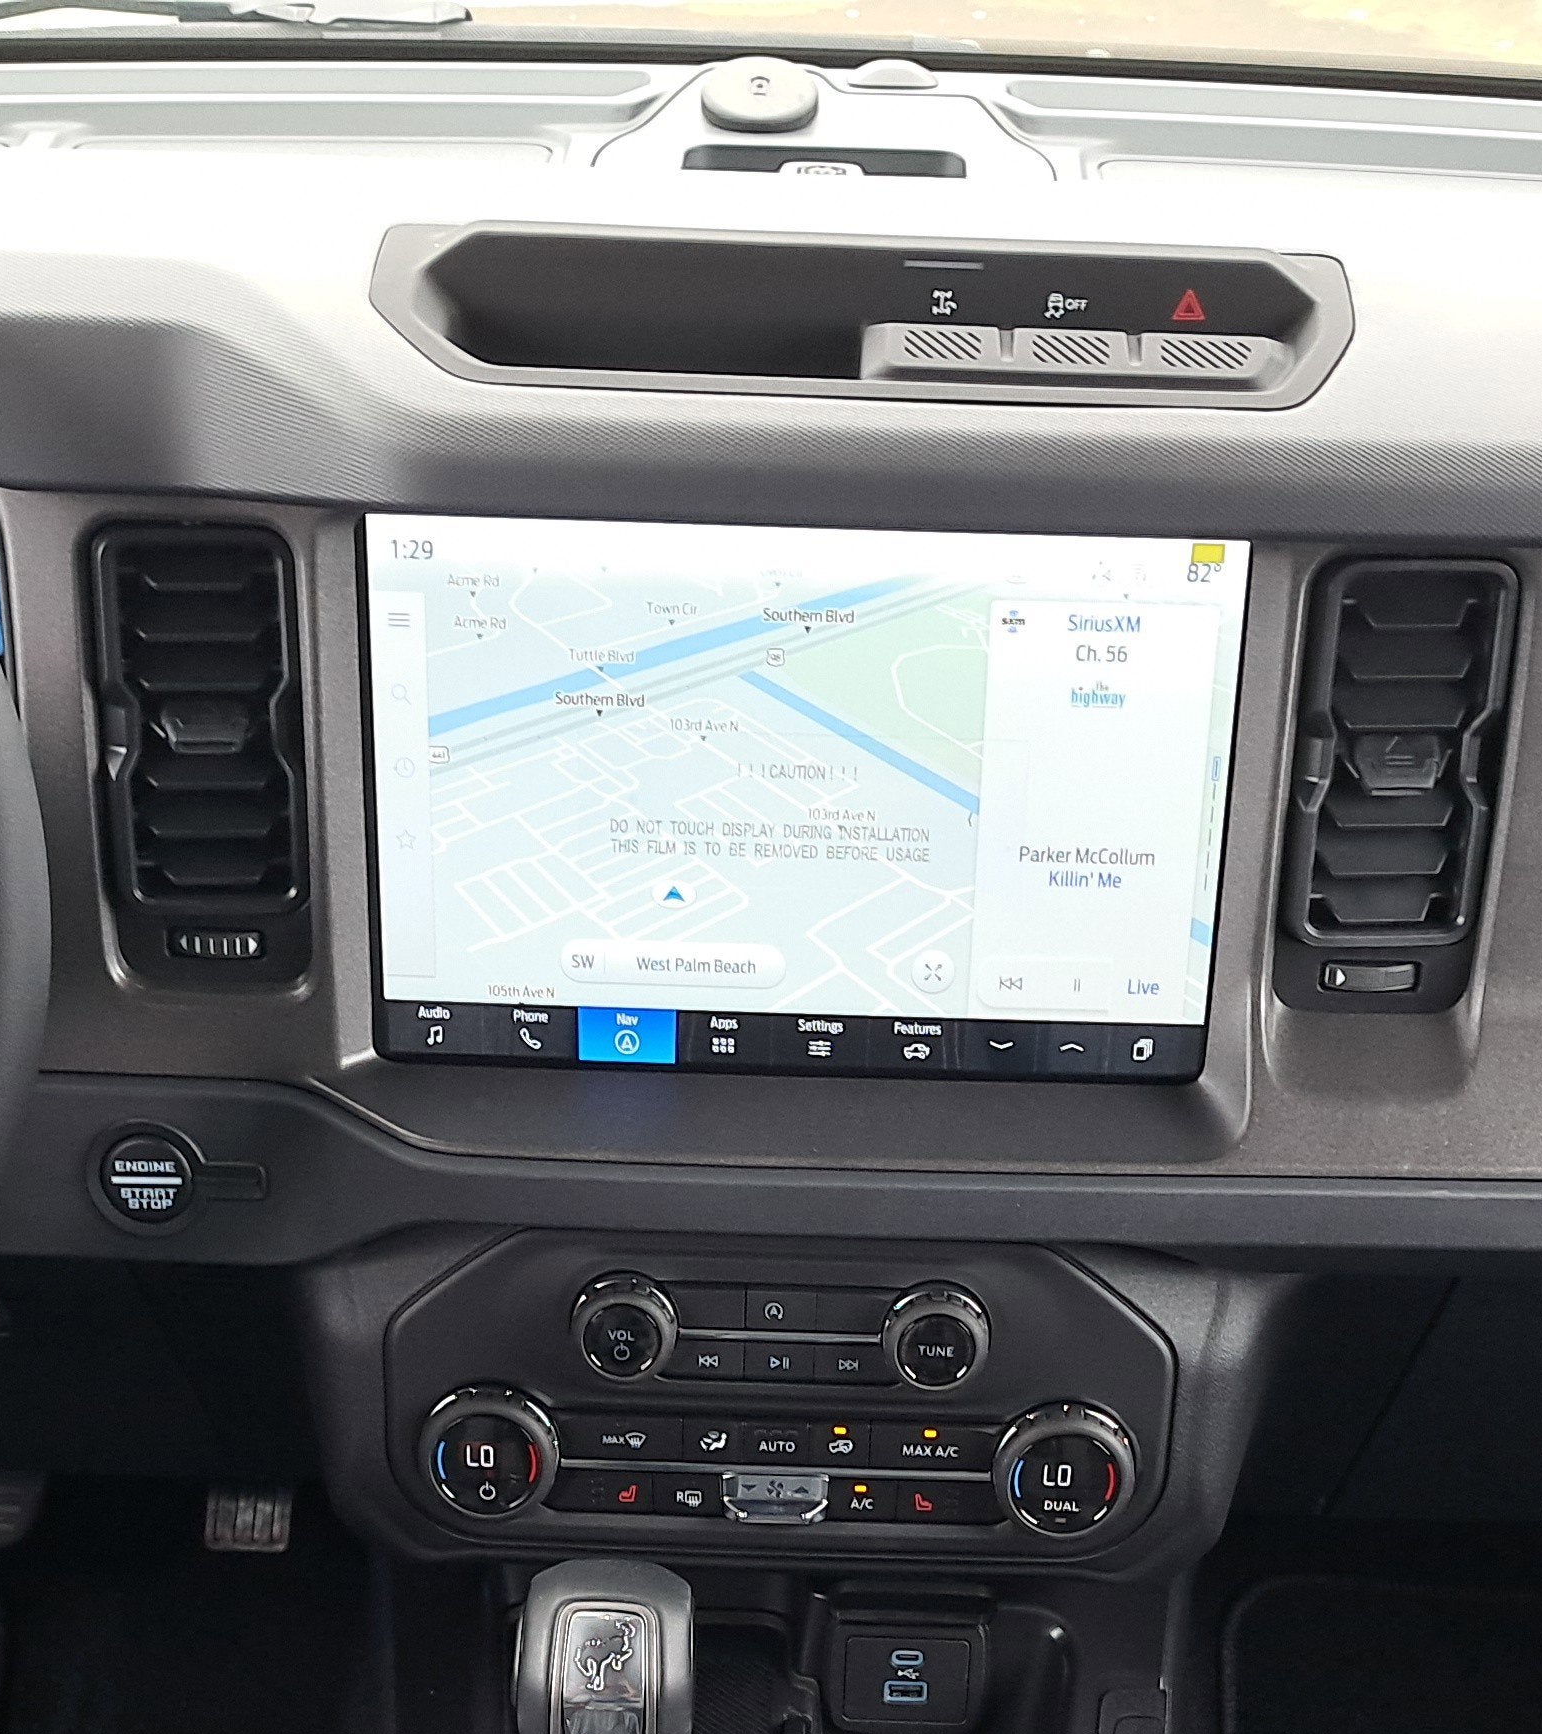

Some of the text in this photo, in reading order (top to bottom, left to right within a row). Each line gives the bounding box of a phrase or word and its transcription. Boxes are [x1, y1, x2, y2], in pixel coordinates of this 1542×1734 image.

[1065, 298, 1089, 312] OFF
[390, 538, 435, 562] 1:29
[447, 573, 500, 588] Acme Rd
[647, 602, 681, 616] Town
[763, 607, 855, 624] Southern Blvd
[454, 616, 507, 631] Acme Rd
[1067, 614, 1141, 633] SiriusXM
[569, 649, 635, 664] Tuttle Blvd
[1075, 644, 1128, 662] Ch. 56
[555, 692, 645, 708] Southern Blvd
[1071, 687, 1126, 708] highway
[669, 719, 740, 734] 103rd Ave N
[610, 819, 930, 843] DO NOT TOUCH DISPLAY DURING INSTALLATION
[610, 839, 930, 863] THIS FILM IS TO BE REMOVED BEFORE USAGE
[1019, 846, 1155, 866] Parker McCollum
[1049, 871, 1122, 889] Killin' Me
[571, 955, 595, 969] SW
[637, 956, 757, 975] West Palm Beach
[488, 984, 546, 999] 105th Ave
[1127, 978, 1160, 996] Live
[418, 1005, 452, 1020] Audio
[513, 1008, 550, 1025] Phone
[616, 1012, 639, 1027] Nav
[709, 1015, 739, 1032] Apps
[798, 1018, 844, 1035] Settings
[893, 1020, 942, 1036] Features
[114, 1160, 176, 1173] ENGINE
[120, 1187, 177, 1200] START
[128, 1199, 173, 1210] STOP
[608, 1330, 635, 1342] VOL
[917, 1345, 955, 1357] TUNE
[602, 1434, 625, 1445] MAX
[759, 1440, 796, 1453] AUTO
[466, 1444, 494, 1468] LO
[902, 1444, 959, 1458] MAX A/C
[1042, 1464, 1072, 1487] LO
[850, 1497, 874, 1510] A/C
[1044, 1500, 1080, 1512] DUAL
